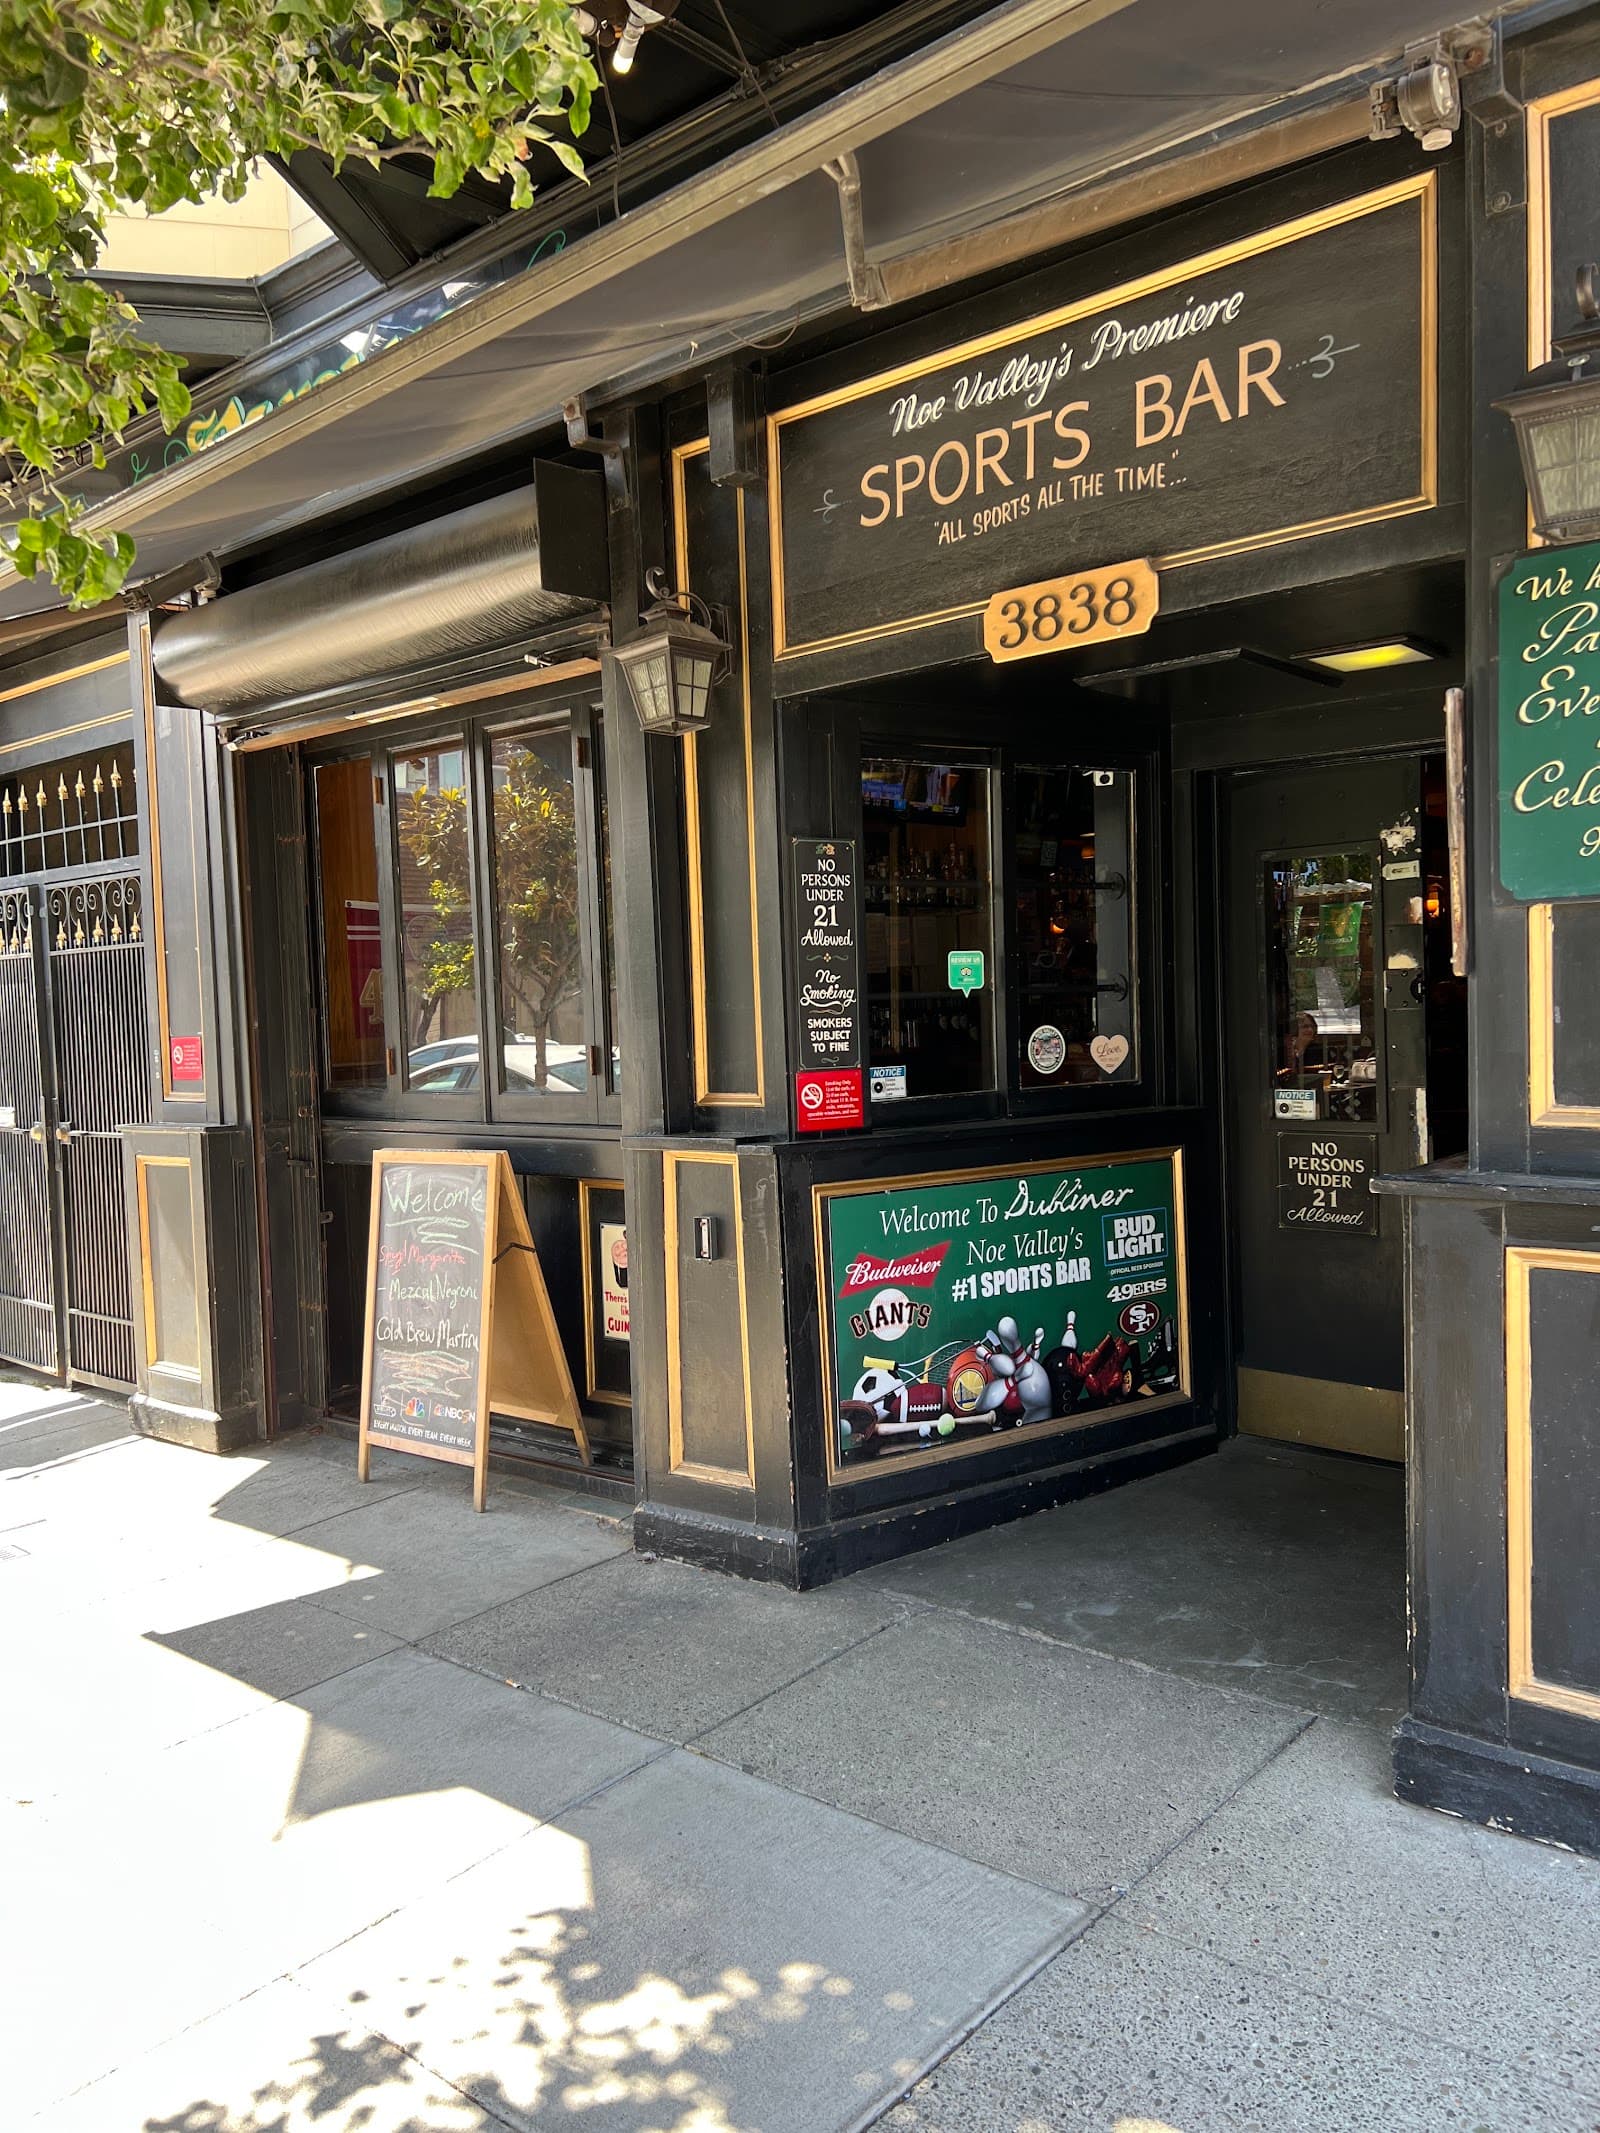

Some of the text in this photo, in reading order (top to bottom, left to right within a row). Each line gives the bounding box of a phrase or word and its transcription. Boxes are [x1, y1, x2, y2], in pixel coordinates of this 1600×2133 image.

[890, 291, 1245, 437] Noe Valley's Premiere
[859, 338, 1288, 528] SPORTS BAR
[973, 494, 1030, 537] SPORTS
[1037, 481, 1065, 509] ALL
[1069, 472, 1104, 498] THE
[1516, 567, 1574, 600] We
[1000, 578, 1137, 649] 3838
[817, 859, 836, 872] NO
[801, 874, 851, 887] PERSONS
[806, 888, 844, 902] UNDER
[813, 904, 839, 927] 21
[801, 929, 853, 947] Allowed
[815, 969, 841, 984] No
[800, 984, 857, 1007] Smoking
[807, 1017, 852, 1029] SMOKERS
[810, 1030, 851, 1041] SUBJECT
[812, 1041, 850, 1053] TO FINE
[873, 1067, 903, 1078] NOTICE
[1279, 1091, 1312, 1100] NOTICE
[1311, 1142, 1338, 1157] NO
[1288, 1156, 1365, 1174] PERSONS
[1297, 1173, 1353, 1189] UNDER
[384, 1174, 485, 1215] Welcome
[1312, 1190, 1338, 1208] 21
[880, 1178, 1134, 1236] Welcome To Dubliner
[1287, 1207, 1364, 1226] Allowed
[1113, 1214, 1156, 1239] BUD
[966, 1226, 1084, 1266] Noe Valley's
[845, 1257, 942, 1286] Budweiser
[952, 1257, 1092, 1302] #1 SPORTS BAR
[1110, 1266, 1131, 1276] OFFICIAL
[389, 1278, 437, 1303] Mezcal
[435, 1271, 479, 1309] Negroni
[1106, 1278, 1168, 1303] 49ERS
[850, 1299, 932, 1340] GIANTS
[1129, 1303, 1155, 1333] SF
[376, 1316, 480, 1352] Cold Brew Martini
[408, 1426, 424, 1437] EVERY
